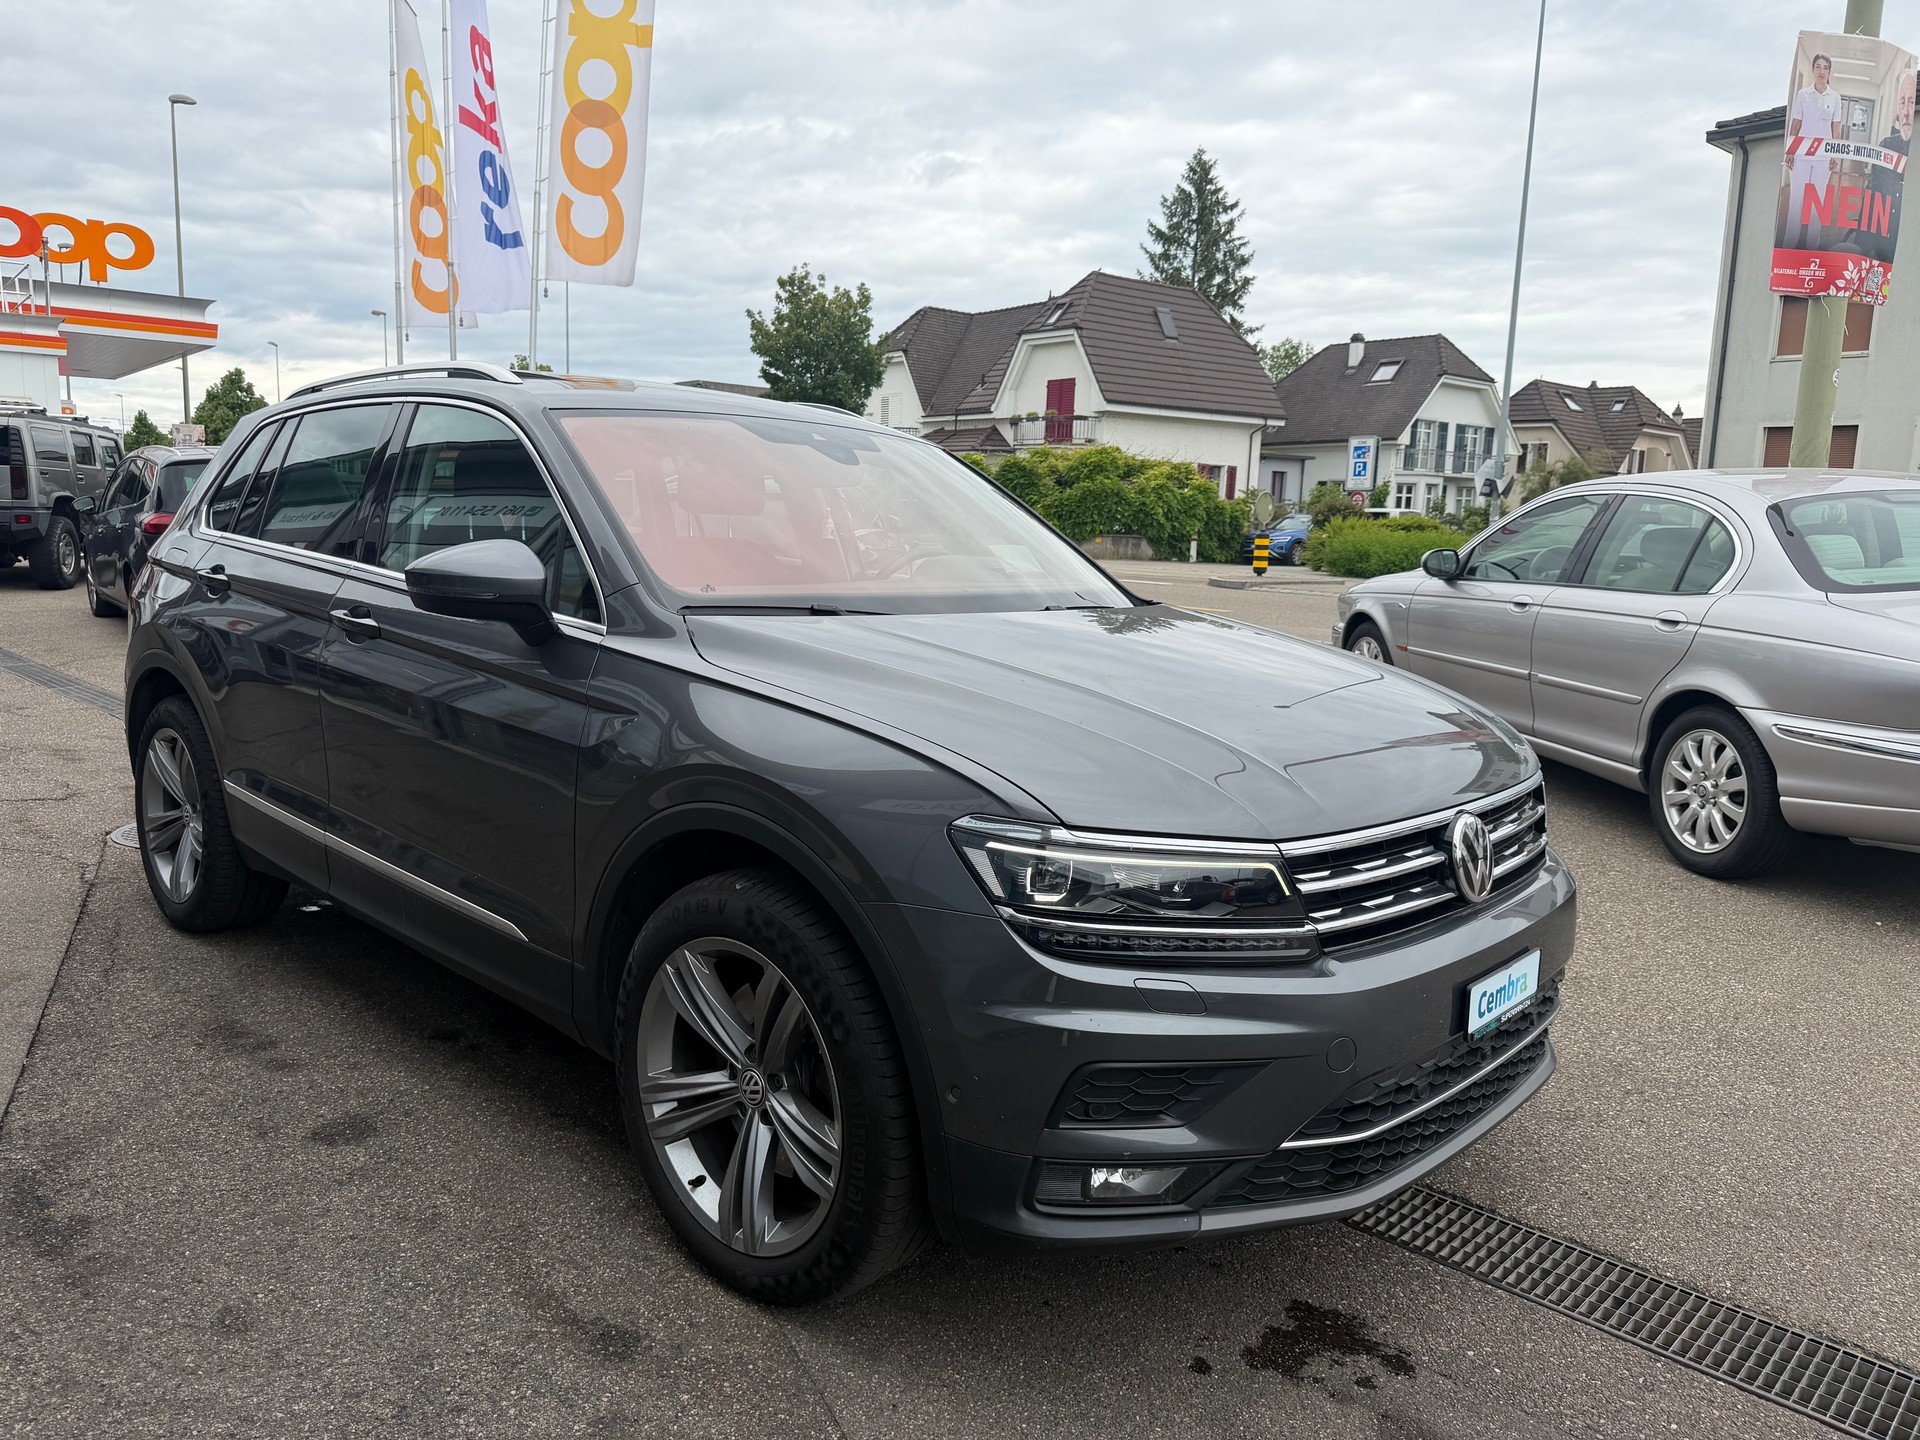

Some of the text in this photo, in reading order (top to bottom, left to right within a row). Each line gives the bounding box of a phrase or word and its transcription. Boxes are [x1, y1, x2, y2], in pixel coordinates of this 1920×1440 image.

[404, 67, 460, 314] coop
[458, 24, 524, 250] reka
[1824, 142, 1883, 161] CHAOS-INITIATIVE
[1477, 972, 1528, 1019] Cembra
